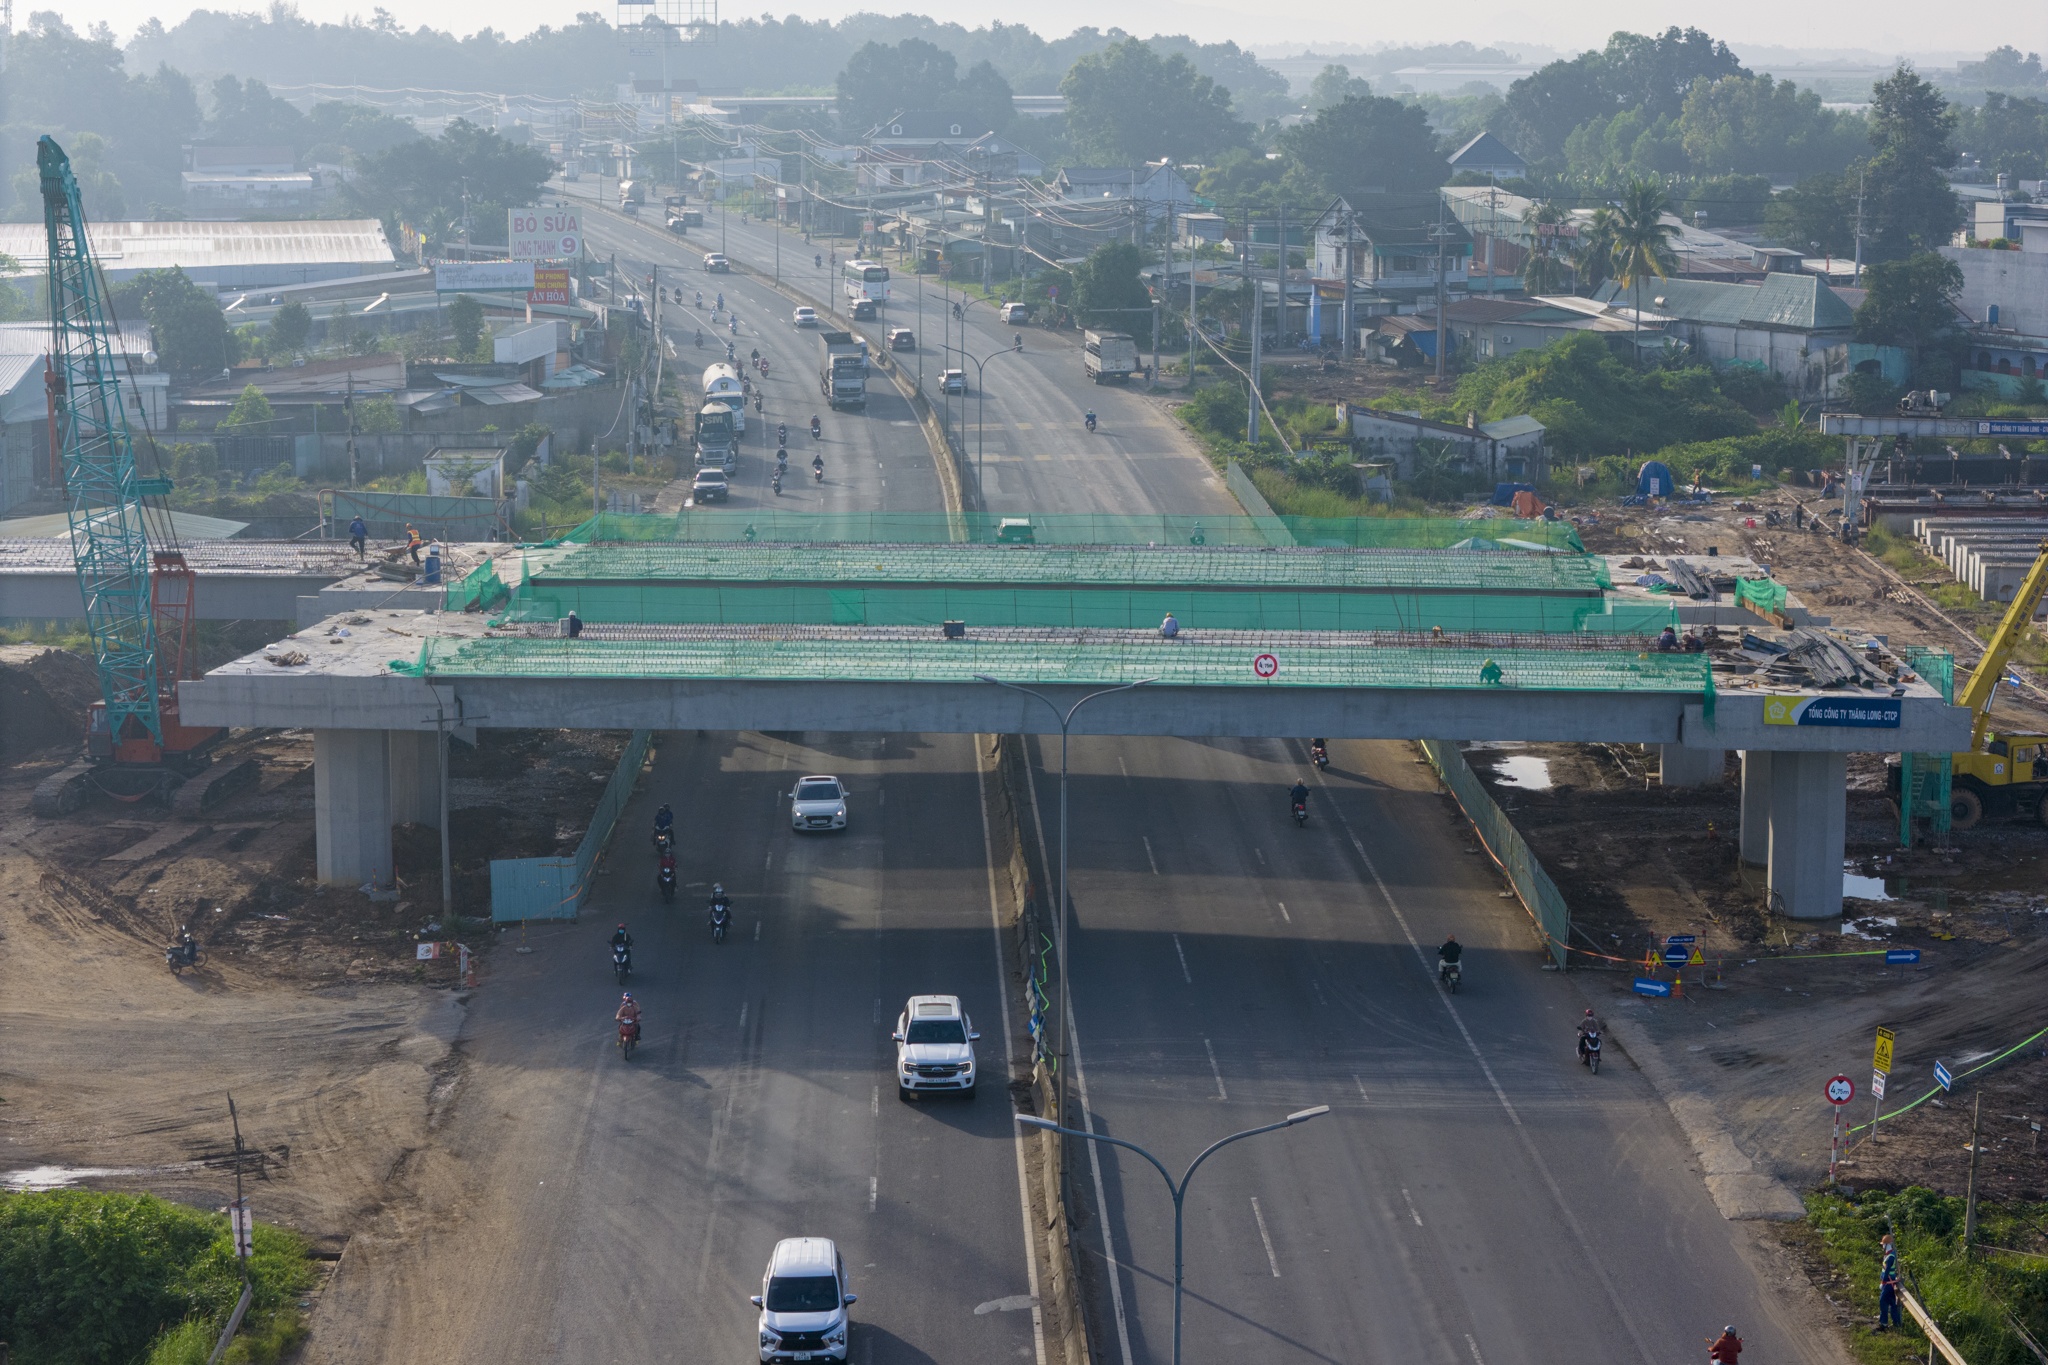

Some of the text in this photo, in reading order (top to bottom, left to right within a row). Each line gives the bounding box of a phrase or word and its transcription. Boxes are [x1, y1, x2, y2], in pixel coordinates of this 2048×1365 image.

[514, 211, 578, 233] BÒ SỮA
[513, 240, 531, 256] LONG
[562, 237, 576, 254] 9
[531, 289, 566, 302] AN HÒA
[705, 415, 723, 424] SM
[1808, 704, 1823, 719] TỔNG
[1823, 706, 1839, 719] CÔNG
[1840, 709, 1848, 719] TY
[1848, 707, 1866, 720] THĂNG
[1830, 1085, 1850, 1095] 4,75m
